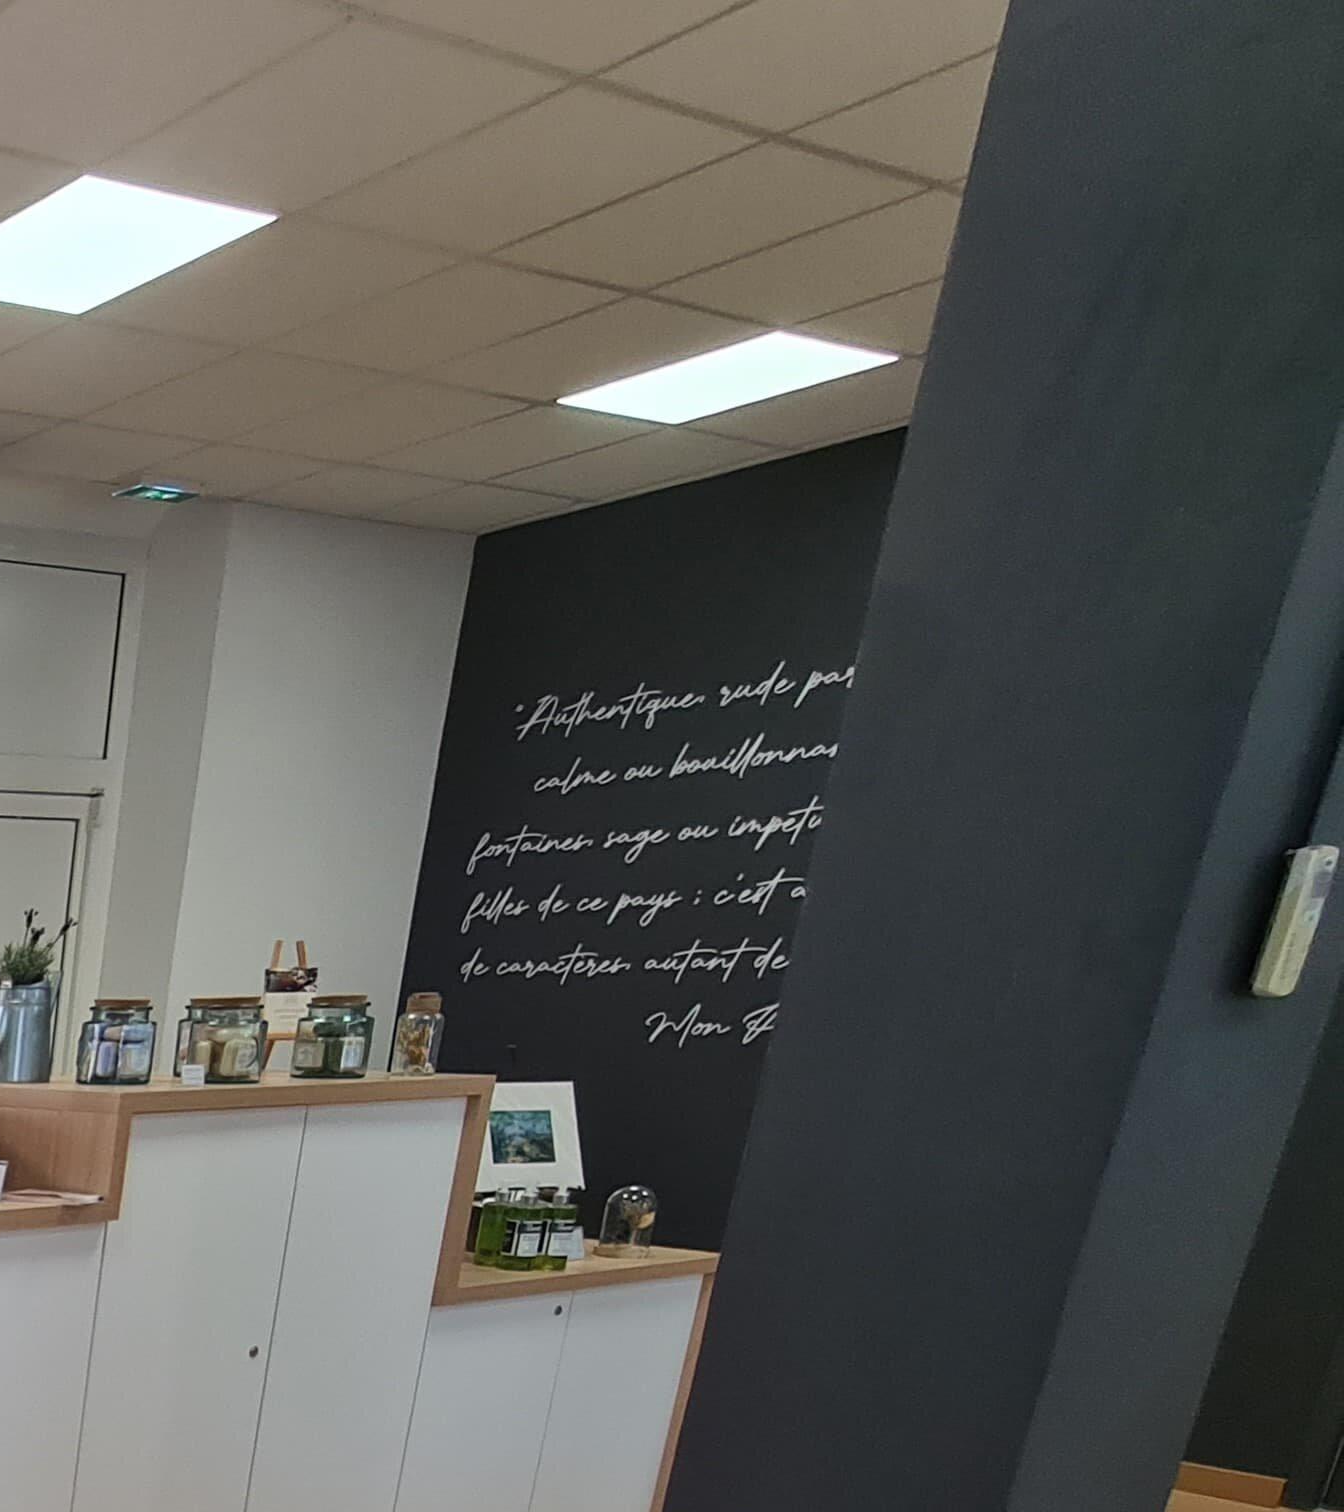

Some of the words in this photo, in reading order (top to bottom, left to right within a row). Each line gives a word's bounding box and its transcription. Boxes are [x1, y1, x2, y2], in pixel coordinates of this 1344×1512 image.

[719, 660, 797, 708] rude
[533, 756, 617, 795] calme
[623, 764, 663, 781] ou
[603, 828, 671, 864] sage
[677, 823, 720, 841] ou
[460, 886, 531, 934] filles
[536, 883, 572, 922] de
[575, 896, 609, 912] ce
[606, 892, 683, 928] pays
[713, 866, 806, 916] c'est
[459, 947, 491, 983] de
[643, 937, 769, 984] autant
[753, 937, 791, 980] de
[644, 1003, 732, 1049] Mon
